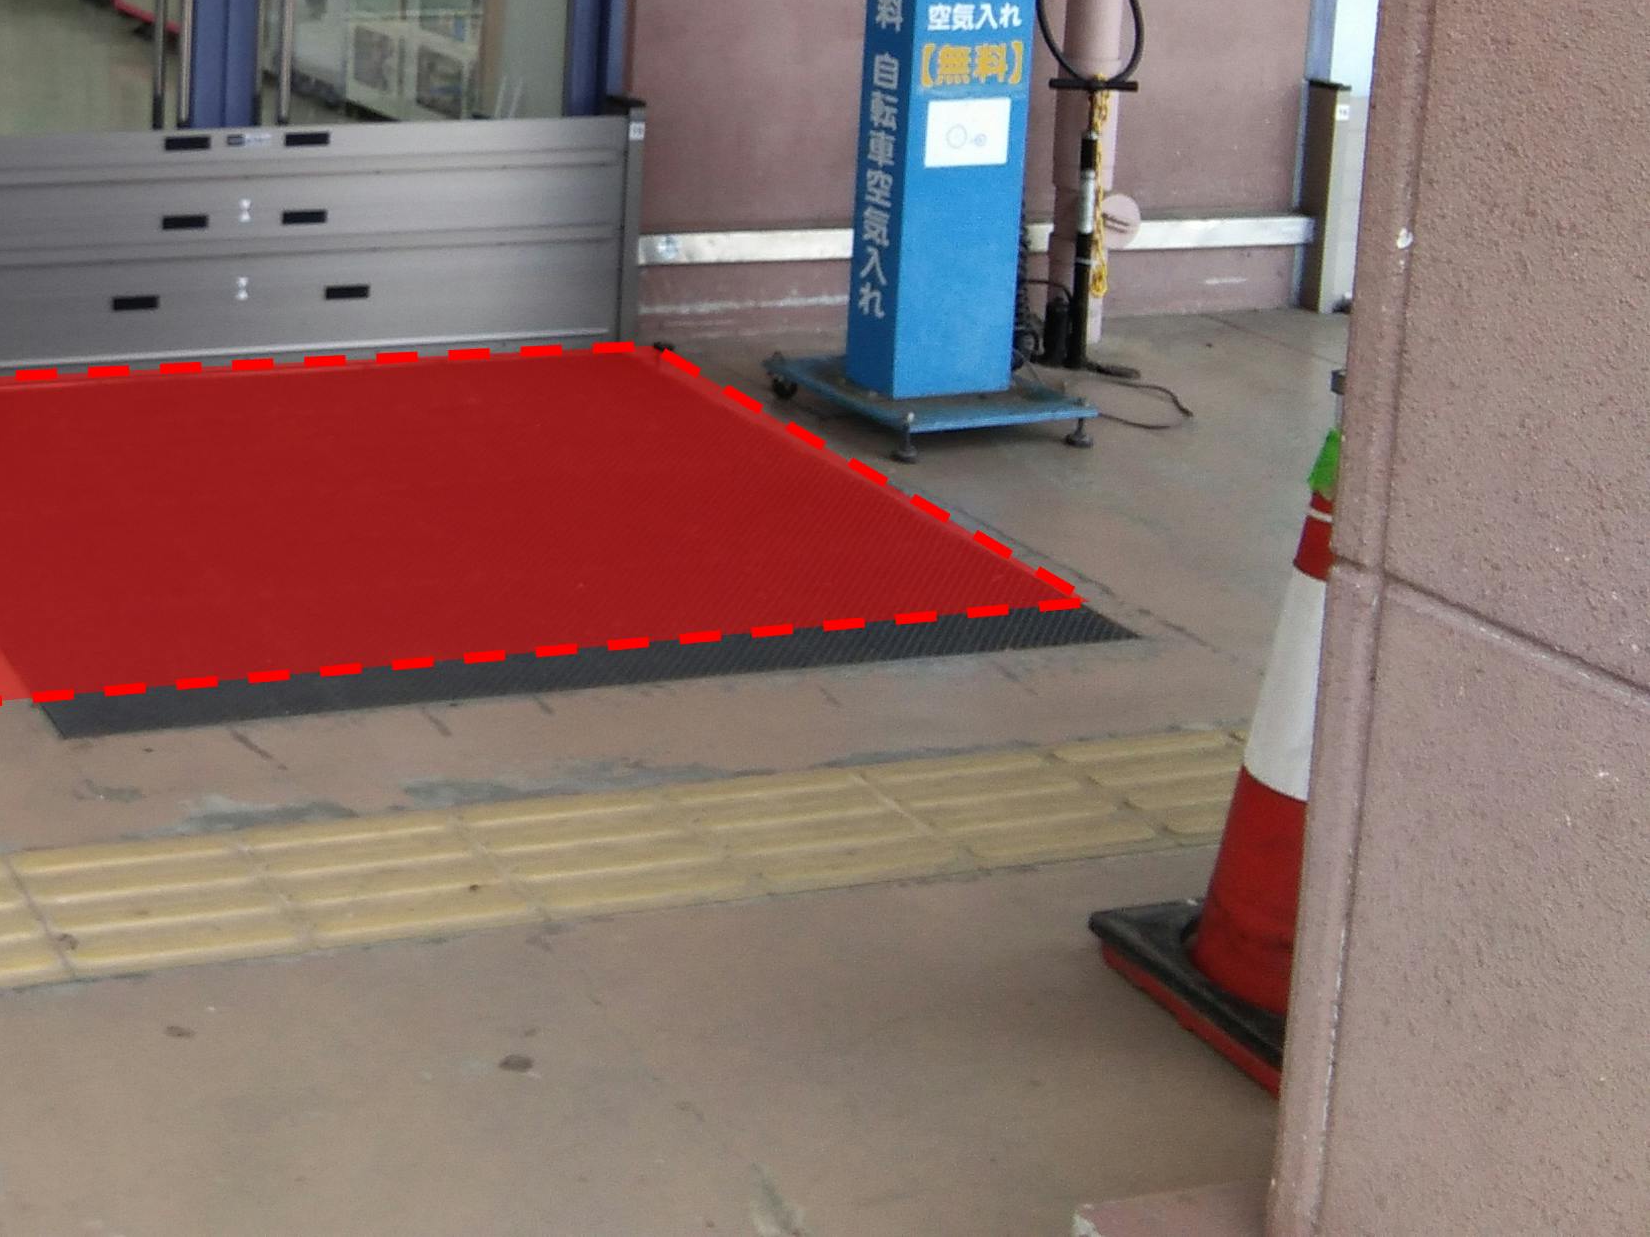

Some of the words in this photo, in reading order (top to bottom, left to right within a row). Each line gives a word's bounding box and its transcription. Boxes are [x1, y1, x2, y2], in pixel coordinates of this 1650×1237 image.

[927, 2, 1022, 31] 空気入れ
[859, 52, 900, 318] 自転車空気入れ
